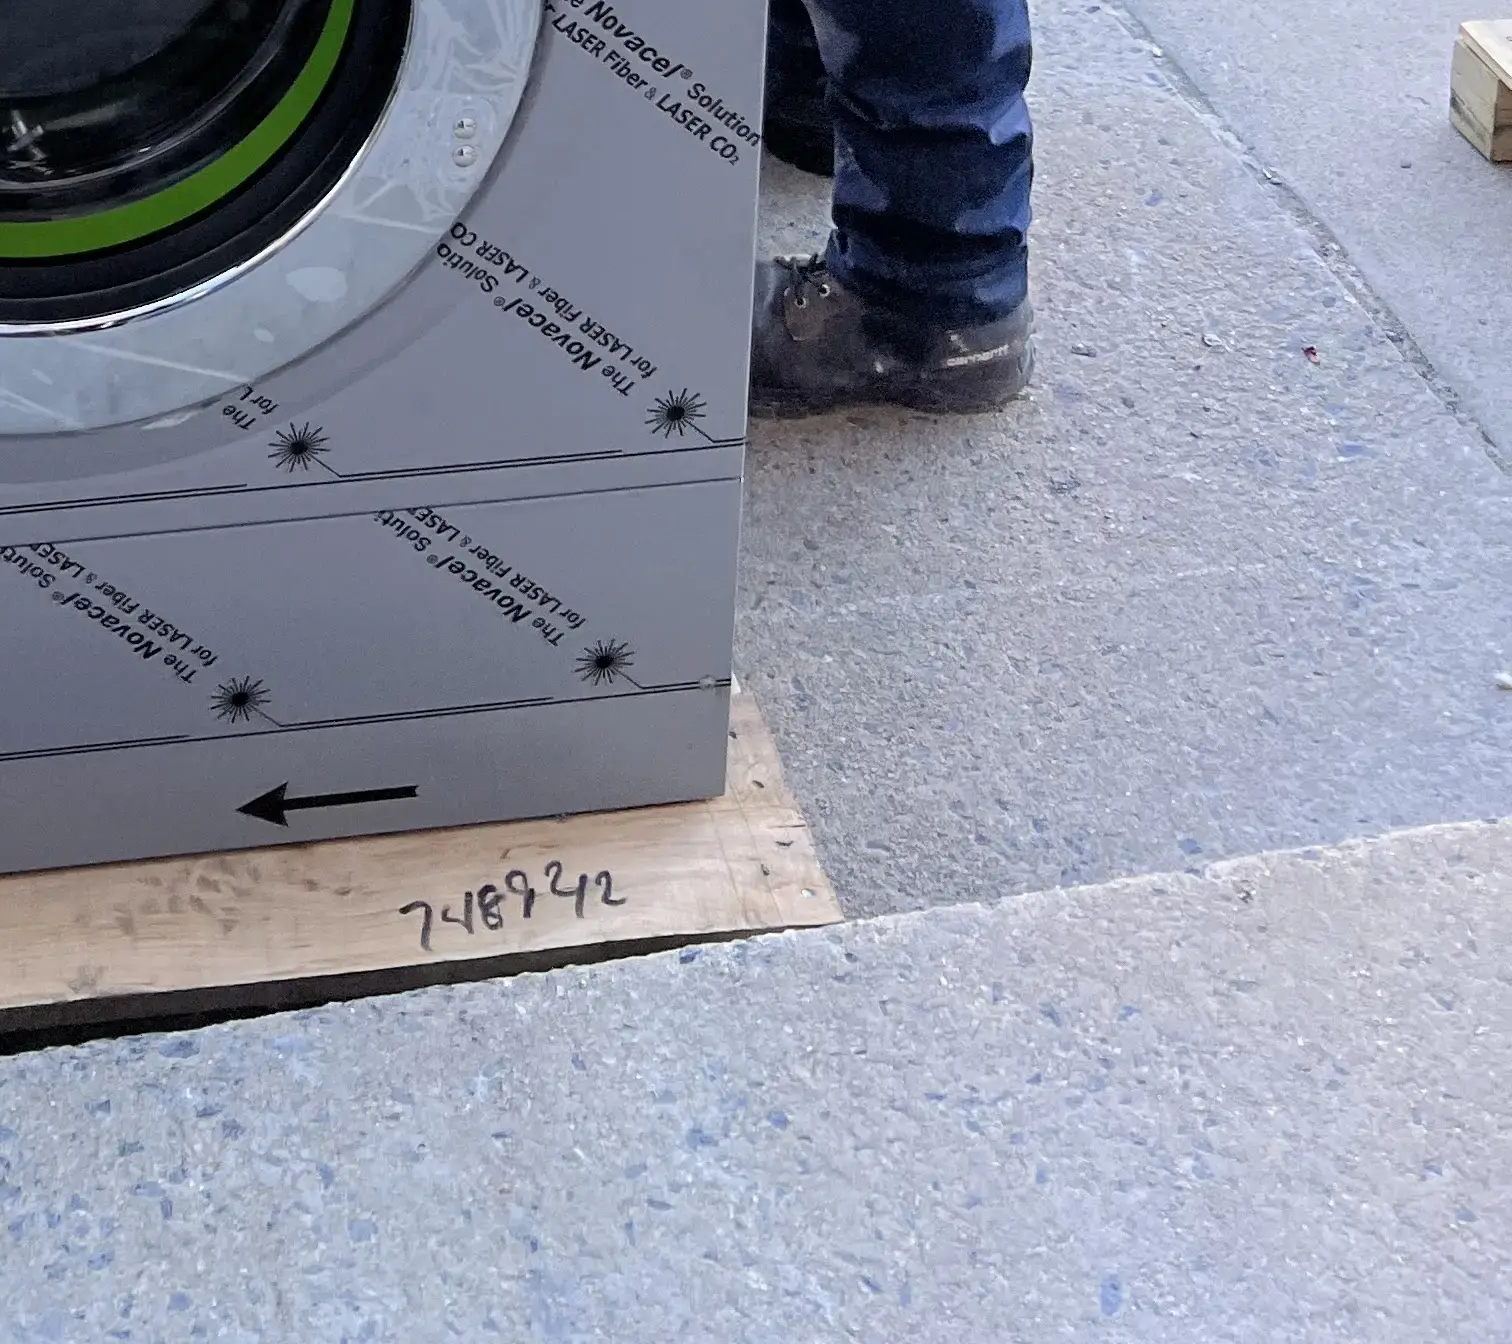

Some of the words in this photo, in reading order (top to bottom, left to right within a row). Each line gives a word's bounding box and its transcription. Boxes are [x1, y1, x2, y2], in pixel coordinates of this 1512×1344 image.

[551, 14, 606, 57] LASER
[603, 50, 648, 89] Fiber
[644, 87, 656, 100] &
[656, 94, 712, 140] LASER
[688, 83, 760, 146] Solution
[437, 244, 499, 292] Solutio
[476, 241, 529, 283] LASER
[529, 276, 541, 289] &
[537, 288, 582, 322] Fiber
[579, 317, 633, 360] LASER
[602, 366, 635, 396] The
[630, 357, 657, 379] for
[222, 405, 256, 430] The
[249, 396, 279, 414] for
[468, 546, 512, 578] Fiber
[95, 582, 140, 614] Fiber
[510, 574, 562, 613] LASER
[138, 609, 193, 650] LASER
[532, 618, 564, 646] The
[559, 609, 586, 629] for
[164, 654, 197, 683] The
[190, 646, 218, 667] for
